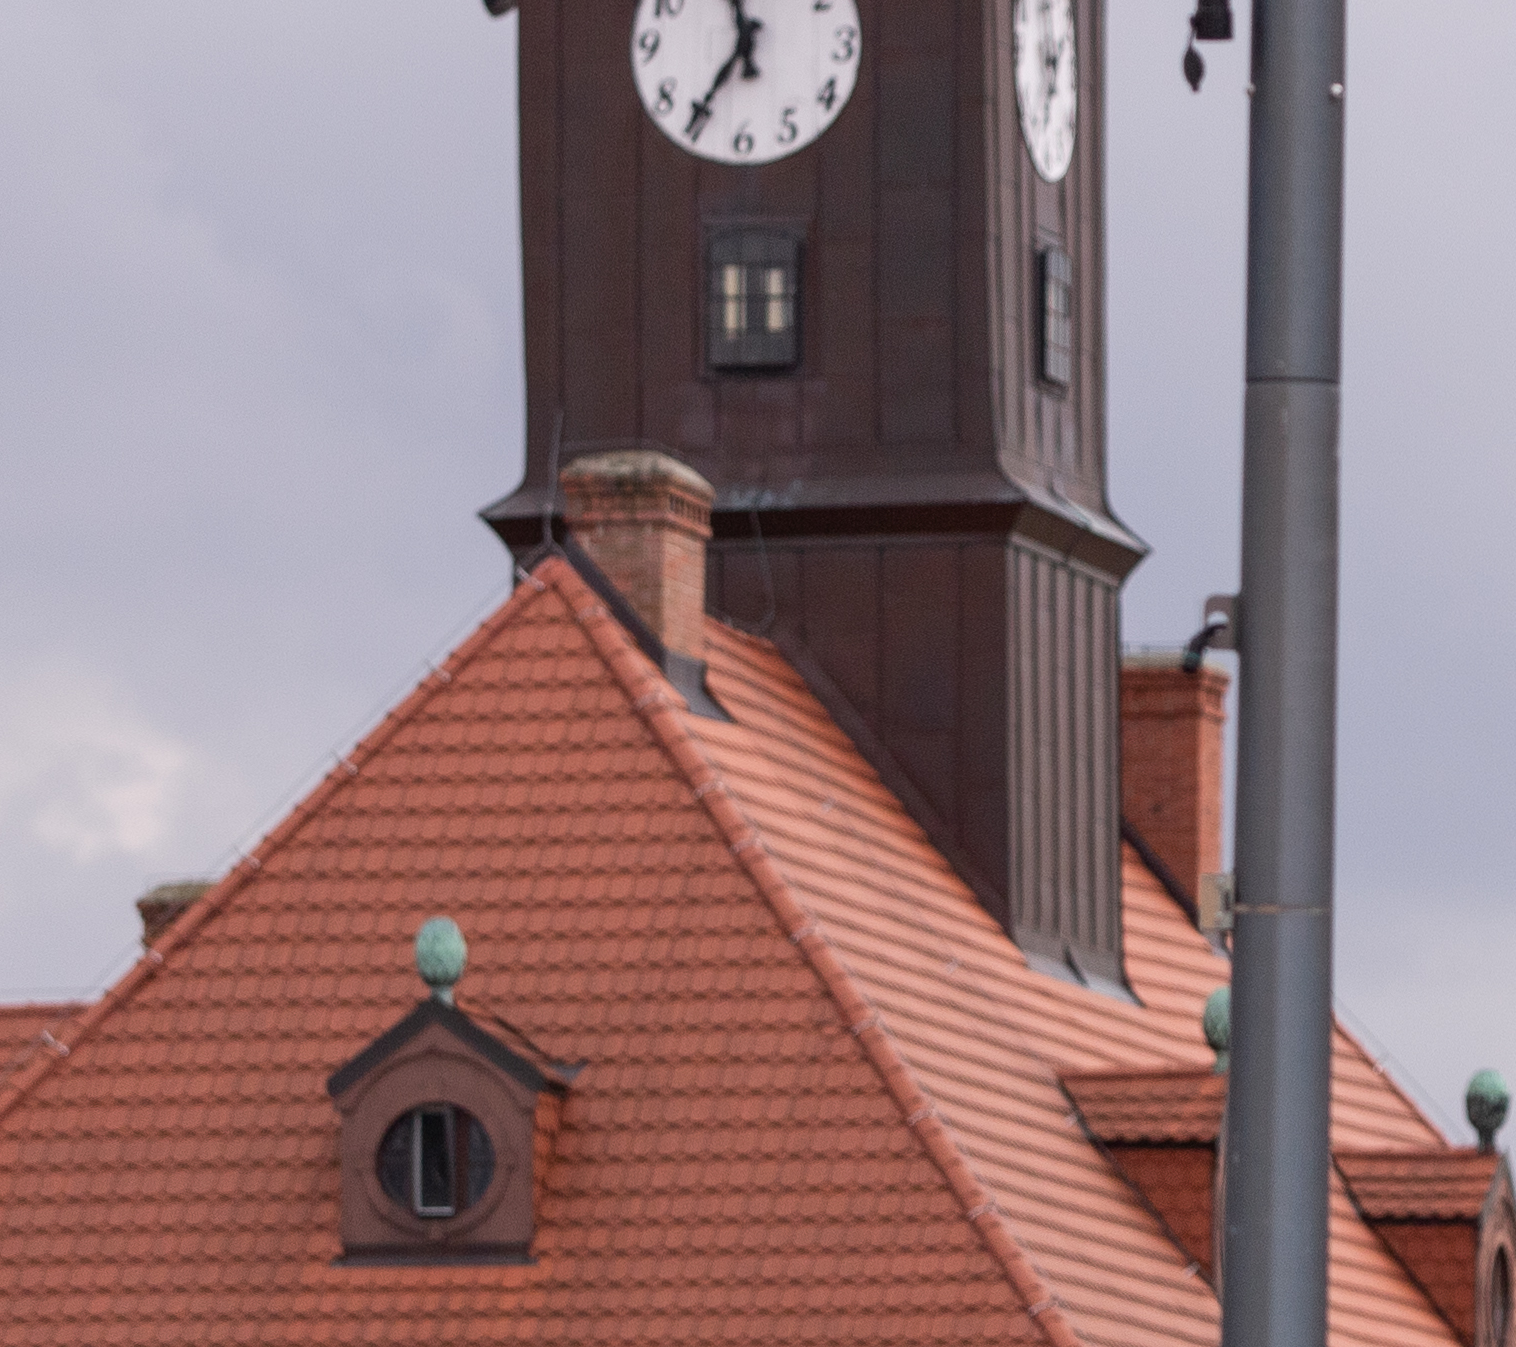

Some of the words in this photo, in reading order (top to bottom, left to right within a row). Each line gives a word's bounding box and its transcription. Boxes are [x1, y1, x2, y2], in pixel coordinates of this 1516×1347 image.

[639, 28, 661, 64] 9
[833, 26, 855, 63] 3
[655, 77, 678, 117] 8
[817, 76, 836, 112] 4
[733, 120, 755, 155] 6
[778, 107, 798, 144] 5
